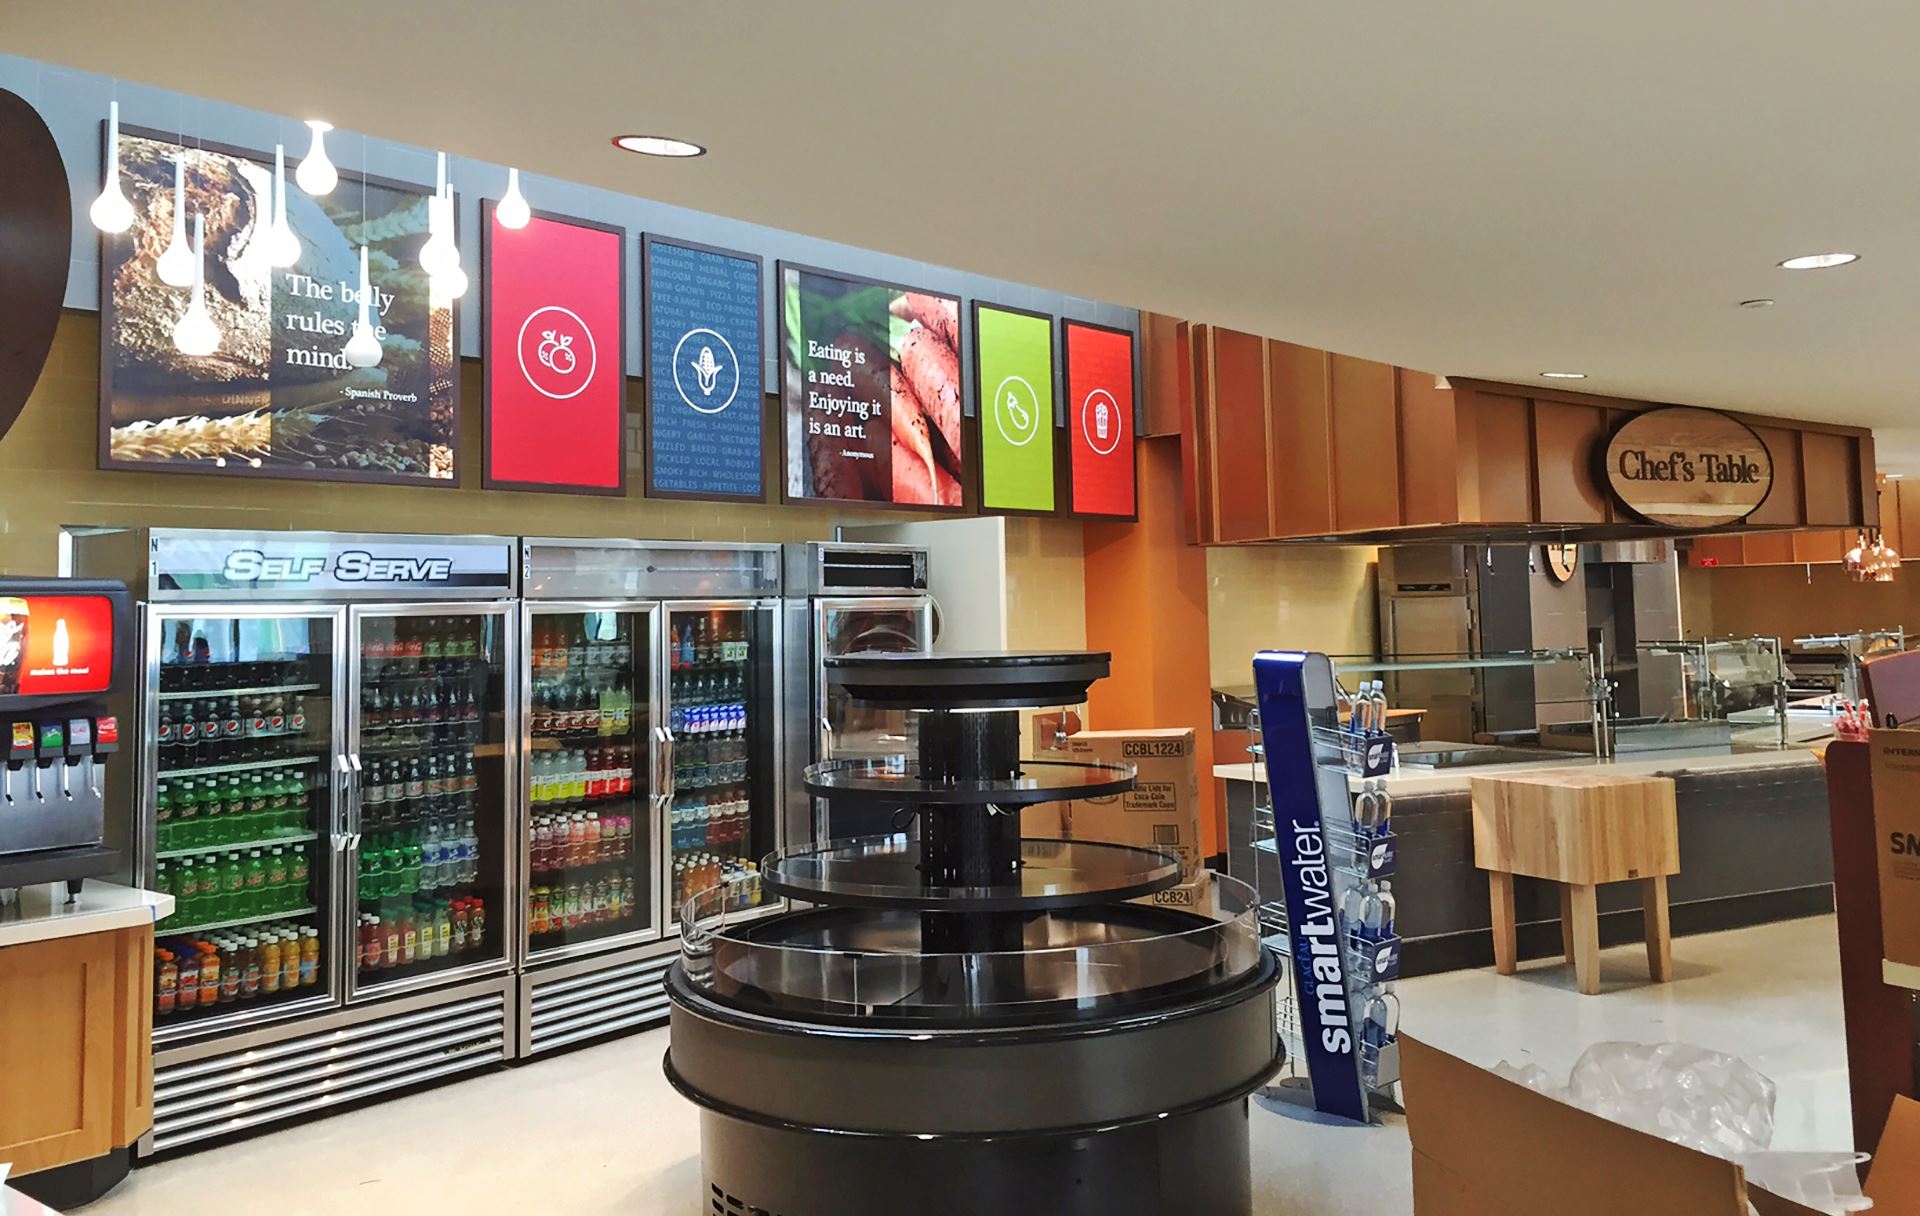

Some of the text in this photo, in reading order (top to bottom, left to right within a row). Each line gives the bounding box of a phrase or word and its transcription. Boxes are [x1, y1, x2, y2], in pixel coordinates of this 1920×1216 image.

[285, 273, 333, 300] The
[286, 312, 344, 336] rules
[808, 340, 865, 368] Eating is
[808, 370, 855, 388] a need.
[383, 390, 418, 403] Proverb
[809, 391, 882, 420] Enjoying it
[809, 418, 867, 439] is an art.
[1700, 454, 1760, 484] Table
[151, 537, 158, 552] N
[1124, 742, 1182, 756] CCBL1224
[1154, 891, 1190, 903] CCB24
